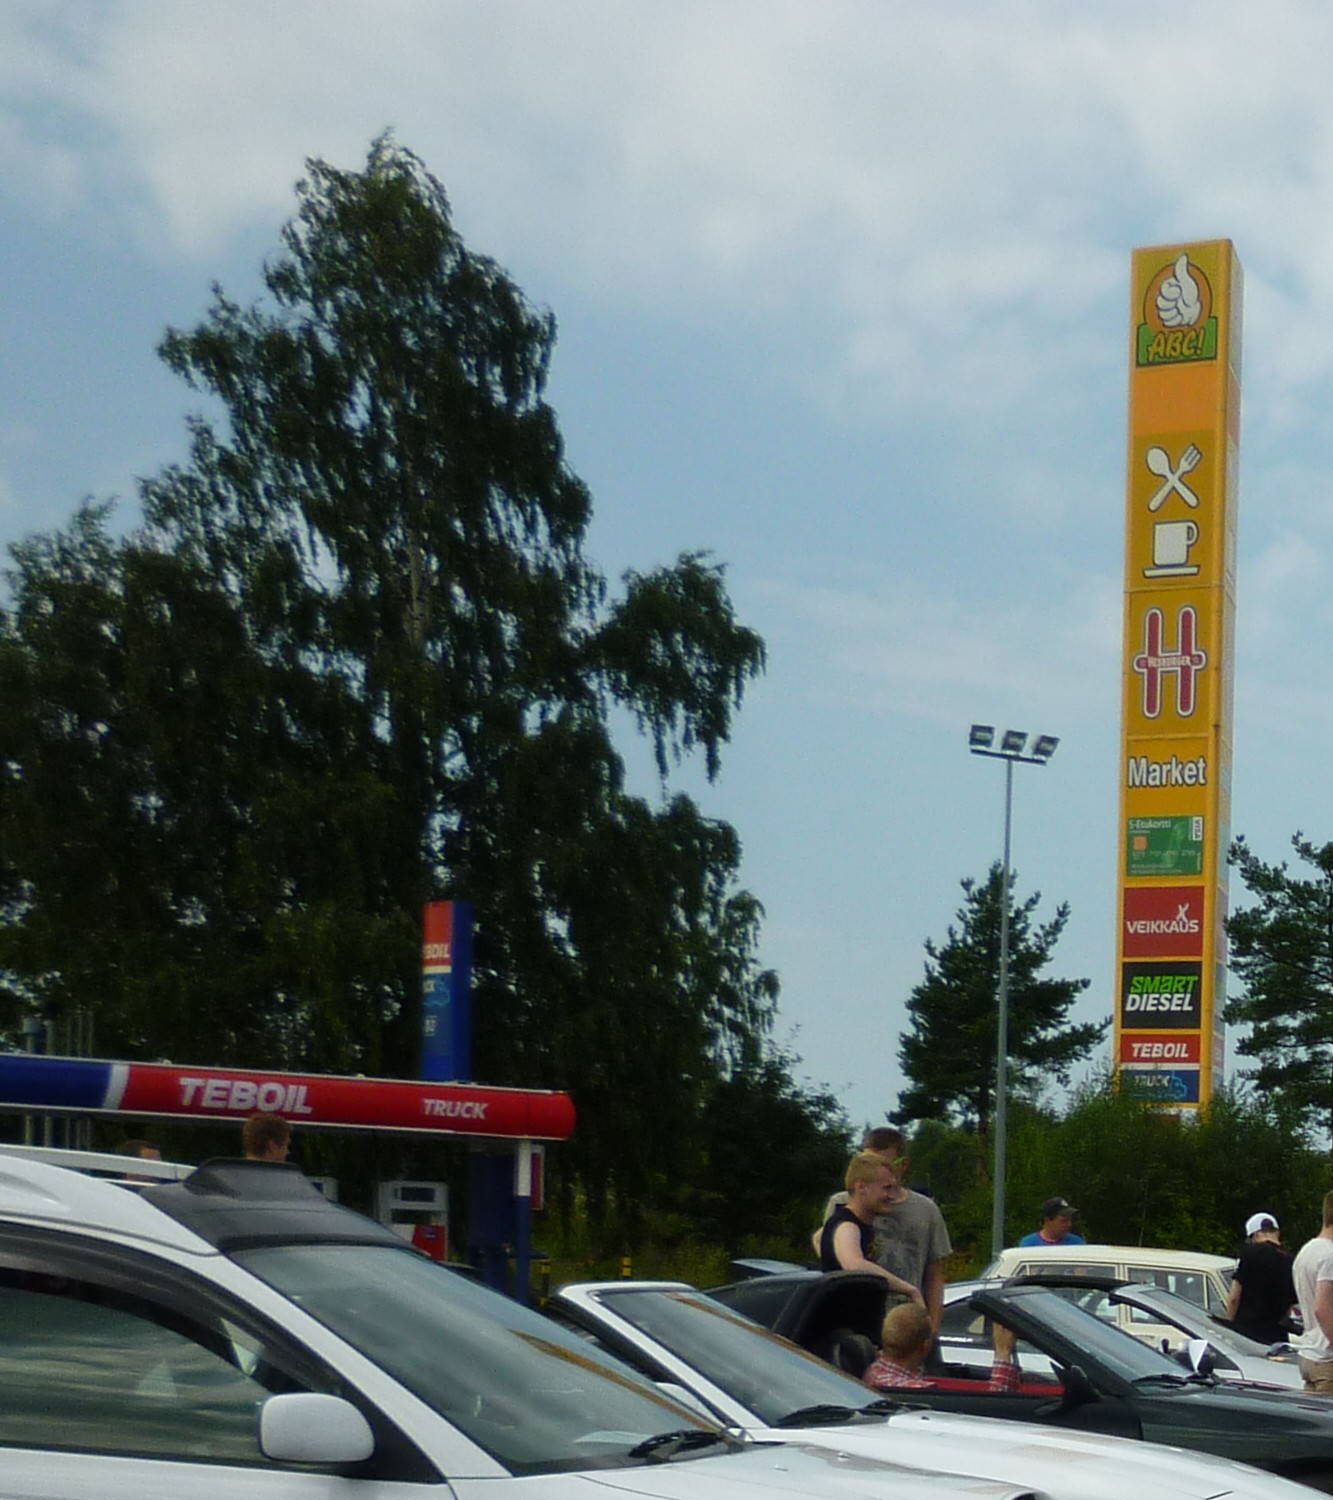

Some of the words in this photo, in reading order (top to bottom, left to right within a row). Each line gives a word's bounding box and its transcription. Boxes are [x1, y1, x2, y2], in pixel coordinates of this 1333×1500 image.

[1147, 326, 1205, 362] ABC!
[1127, 755, 1206, 788] Market
[1126, 919, 1199, 934] VEIKKAUS
[1125, 993, 1193, 1011] DIESEL
[1132, 1043, 1189, 1058] TEBOIL
[180, 1077, 312, 1114] TEBOIL
[423, 1099, 487, 1119] TRUCK
